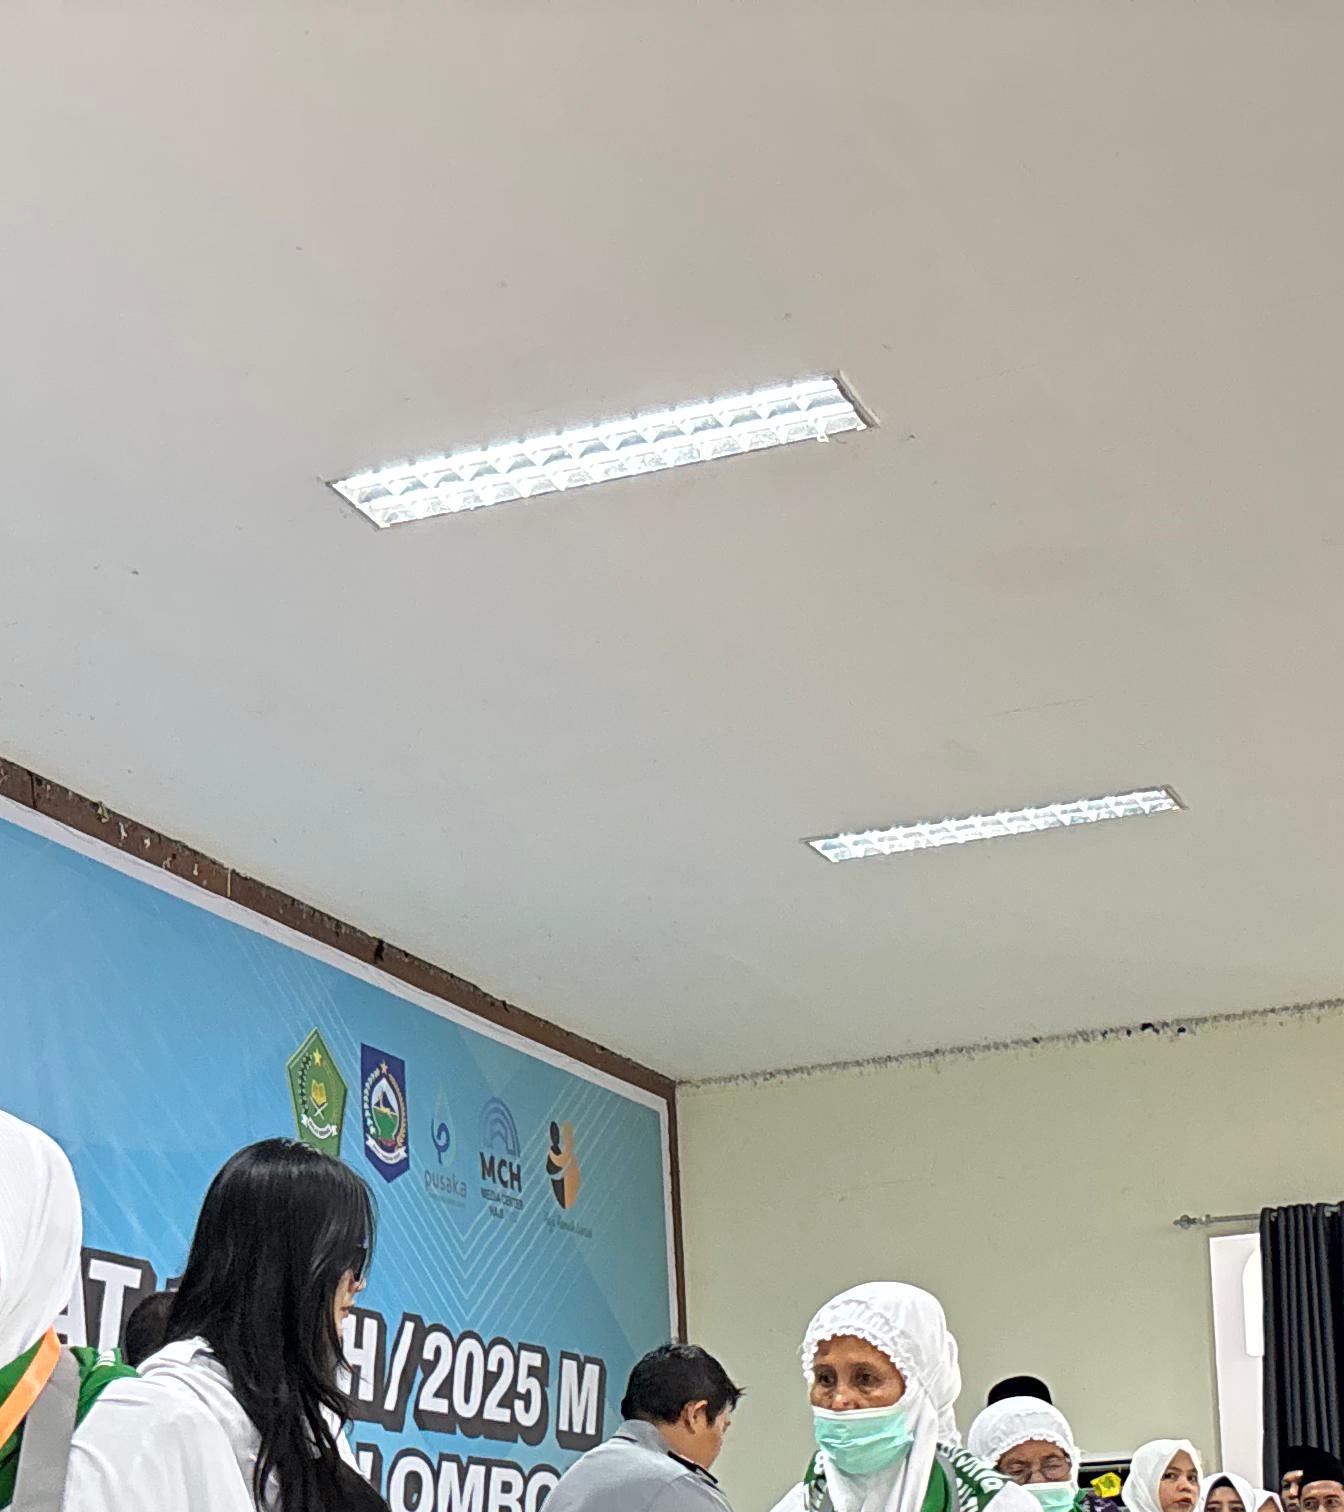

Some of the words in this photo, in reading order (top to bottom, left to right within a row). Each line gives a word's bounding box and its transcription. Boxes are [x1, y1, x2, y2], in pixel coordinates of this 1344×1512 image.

[424, 1170, 467, 1199] pusaka
[479, 1151, 522, 1193] MCH
[558, 1358, 601, 1436] M
